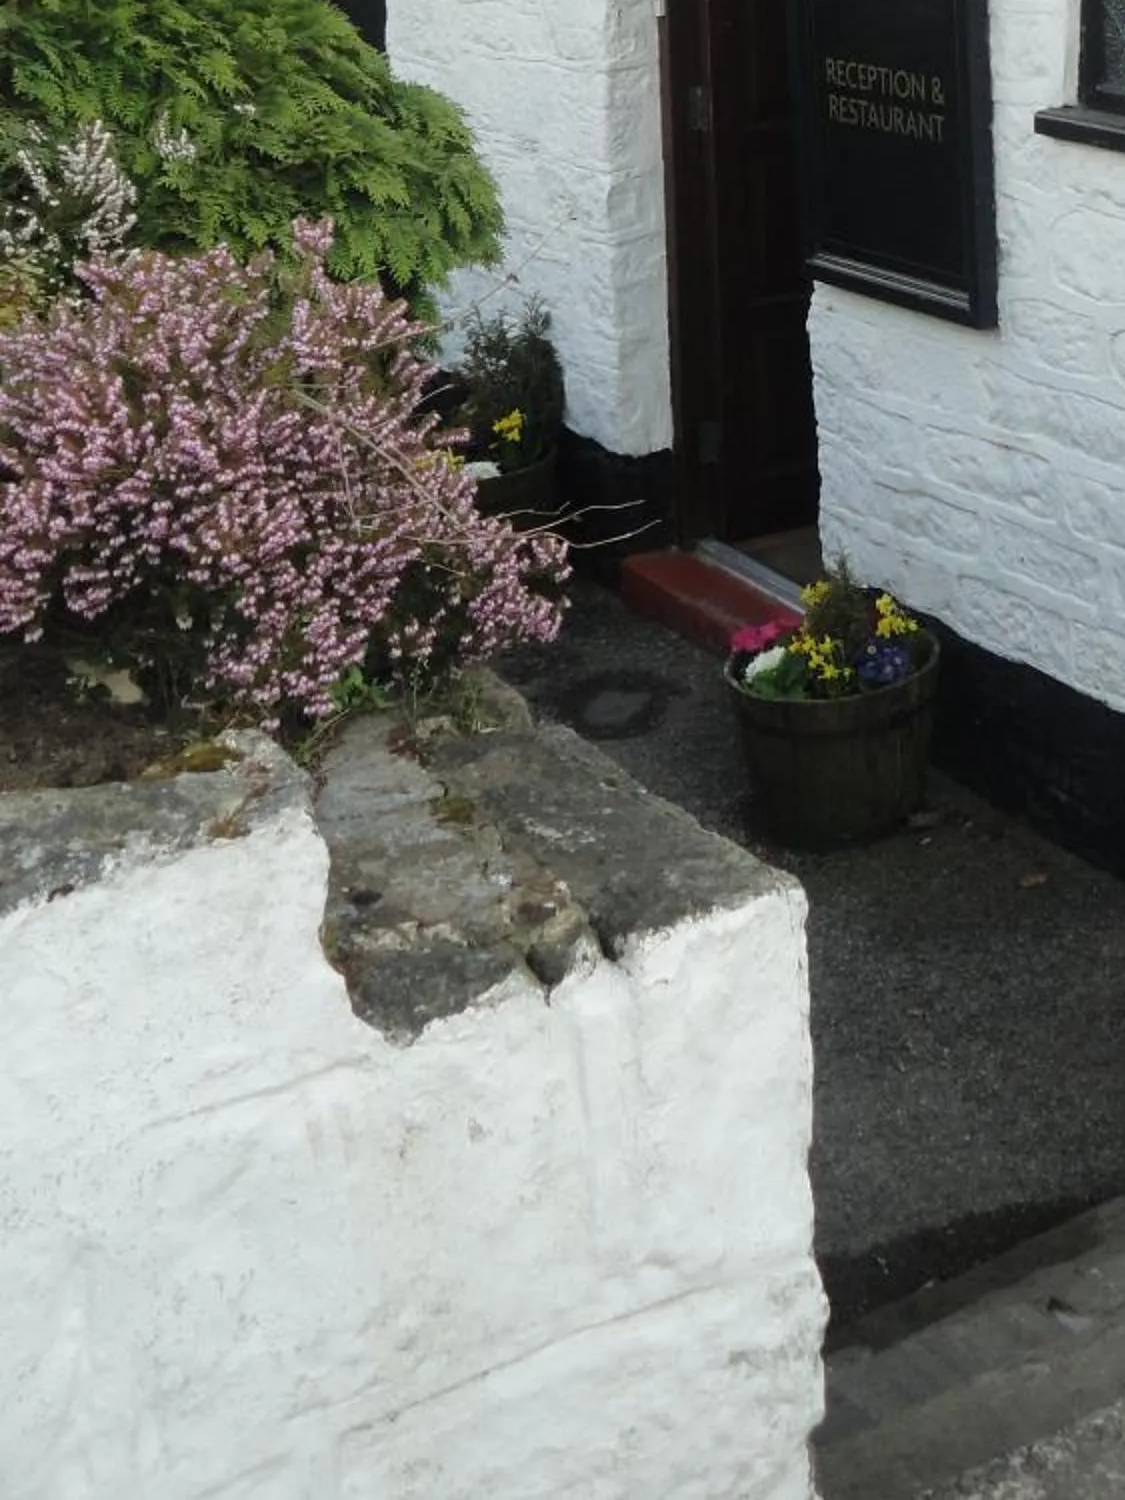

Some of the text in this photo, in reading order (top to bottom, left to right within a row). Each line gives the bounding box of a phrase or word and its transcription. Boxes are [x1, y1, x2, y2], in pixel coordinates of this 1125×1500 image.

[825, 57, 945, 105] RECEPTION &
[828, 93, 945, 143] RESTAURANT
